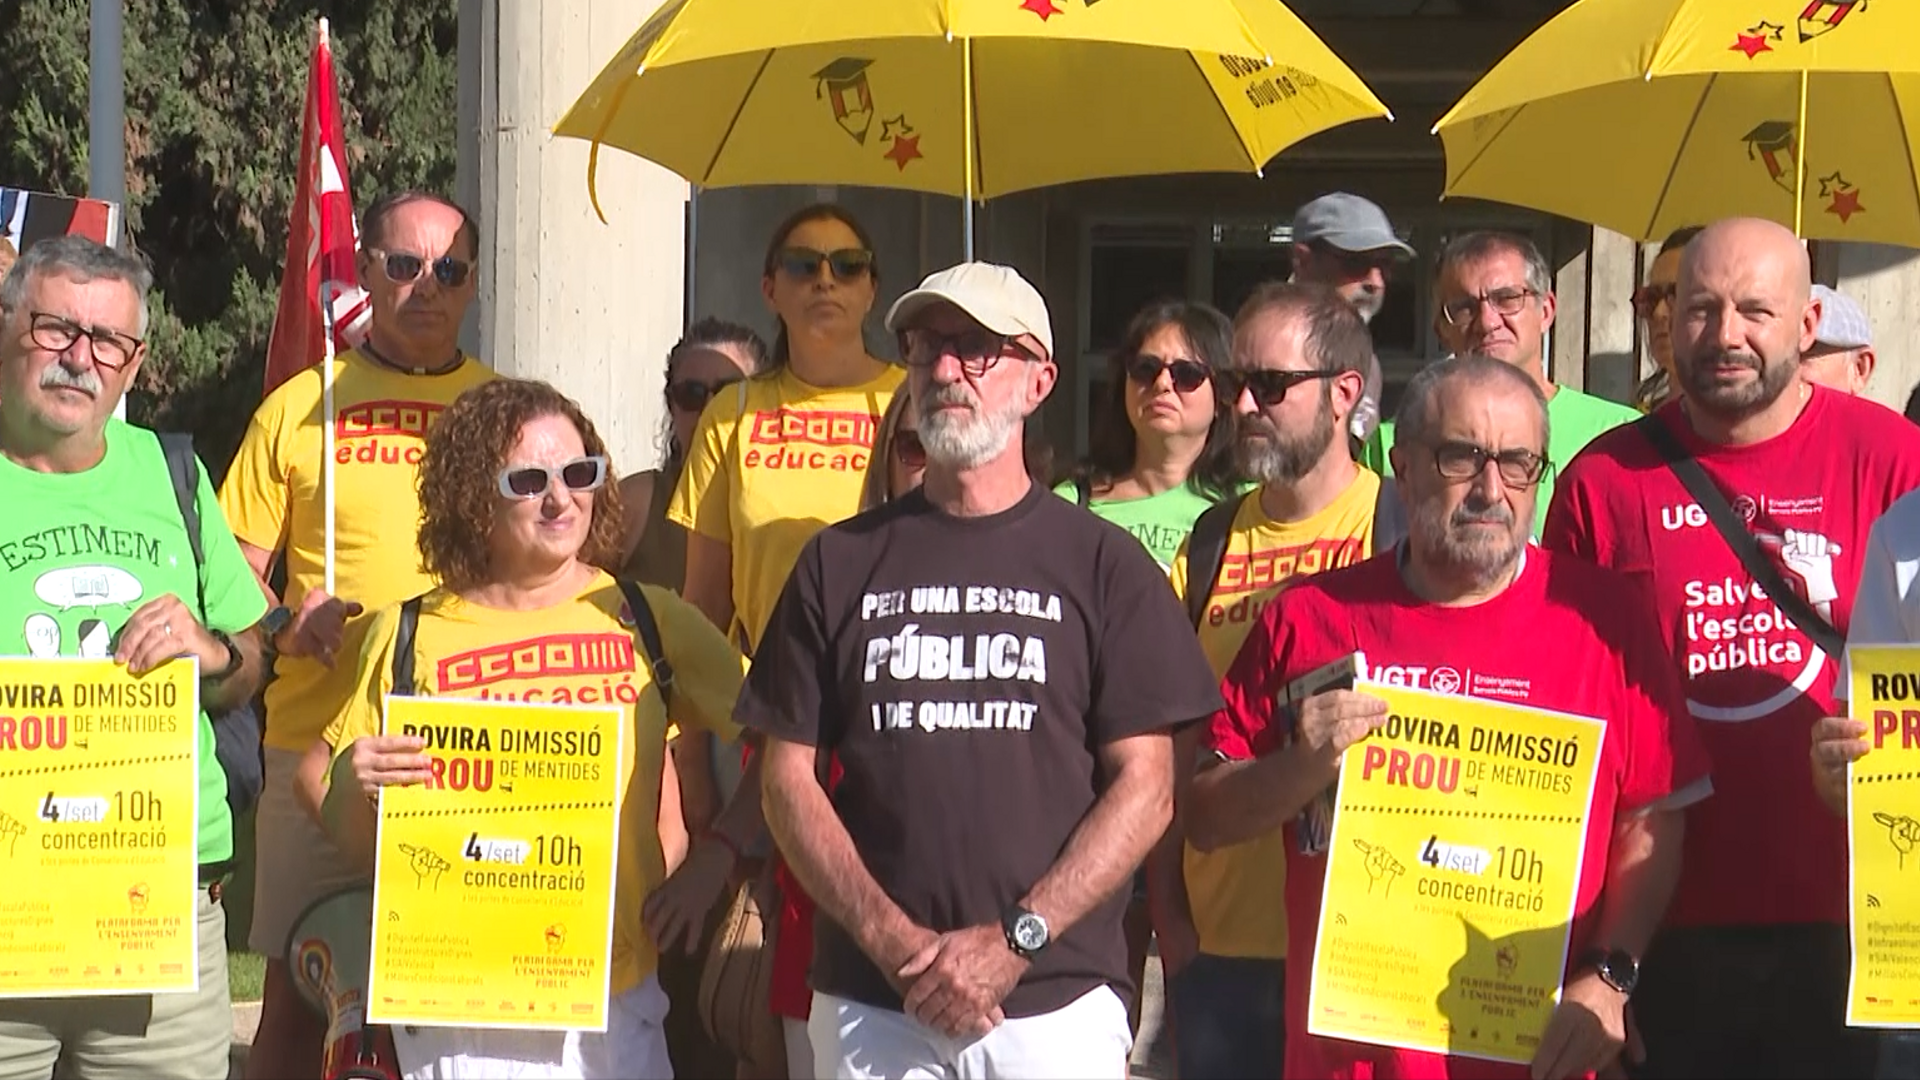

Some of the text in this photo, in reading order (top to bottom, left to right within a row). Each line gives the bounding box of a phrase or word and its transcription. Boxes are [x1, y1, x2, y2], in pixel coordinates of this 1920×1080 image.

[336, 439, 422, 464] educ
[744, 446, 867, 472] educac
[1661, 503, 1708, 531] UG
[0, 524, 161, 572] ESTIMEM
[861, 586, 1062, 622] PER UNA ESCOLA
[1685, 577, 1768, 607] Salve
[864, 623, 1046, 684] PÚBLICA
[1688, 637, 1802, 680] pública
[0, 674, 177, 708] VIRA DIMISSIÓ
[0, 714, 177, 750] ROU DE MENTIDES
[871, 700, 1038, 732] I DE QUALITAT
[1874, 709, 1920, 749] PR
[500, 725, 601, 756] DIMISSIÓ
[1470, 727, 1579, 768] DIMISSIÓ
[425, 757, 600, 792] ROU DE MENTIDES
[1362, 745, 1461, 794] PROU
[1466, 760, 1573, 795] DE MENTIDES
[115, 790, 162, 822] 10h
[41, 825, 167, 850] concentració
[536, 834, 582, 866] 10h
[464, 868, 585, 892] concentració
[1497, 845, 1544, 884] 10h
[1417, 877, 1544, 913] concentració
